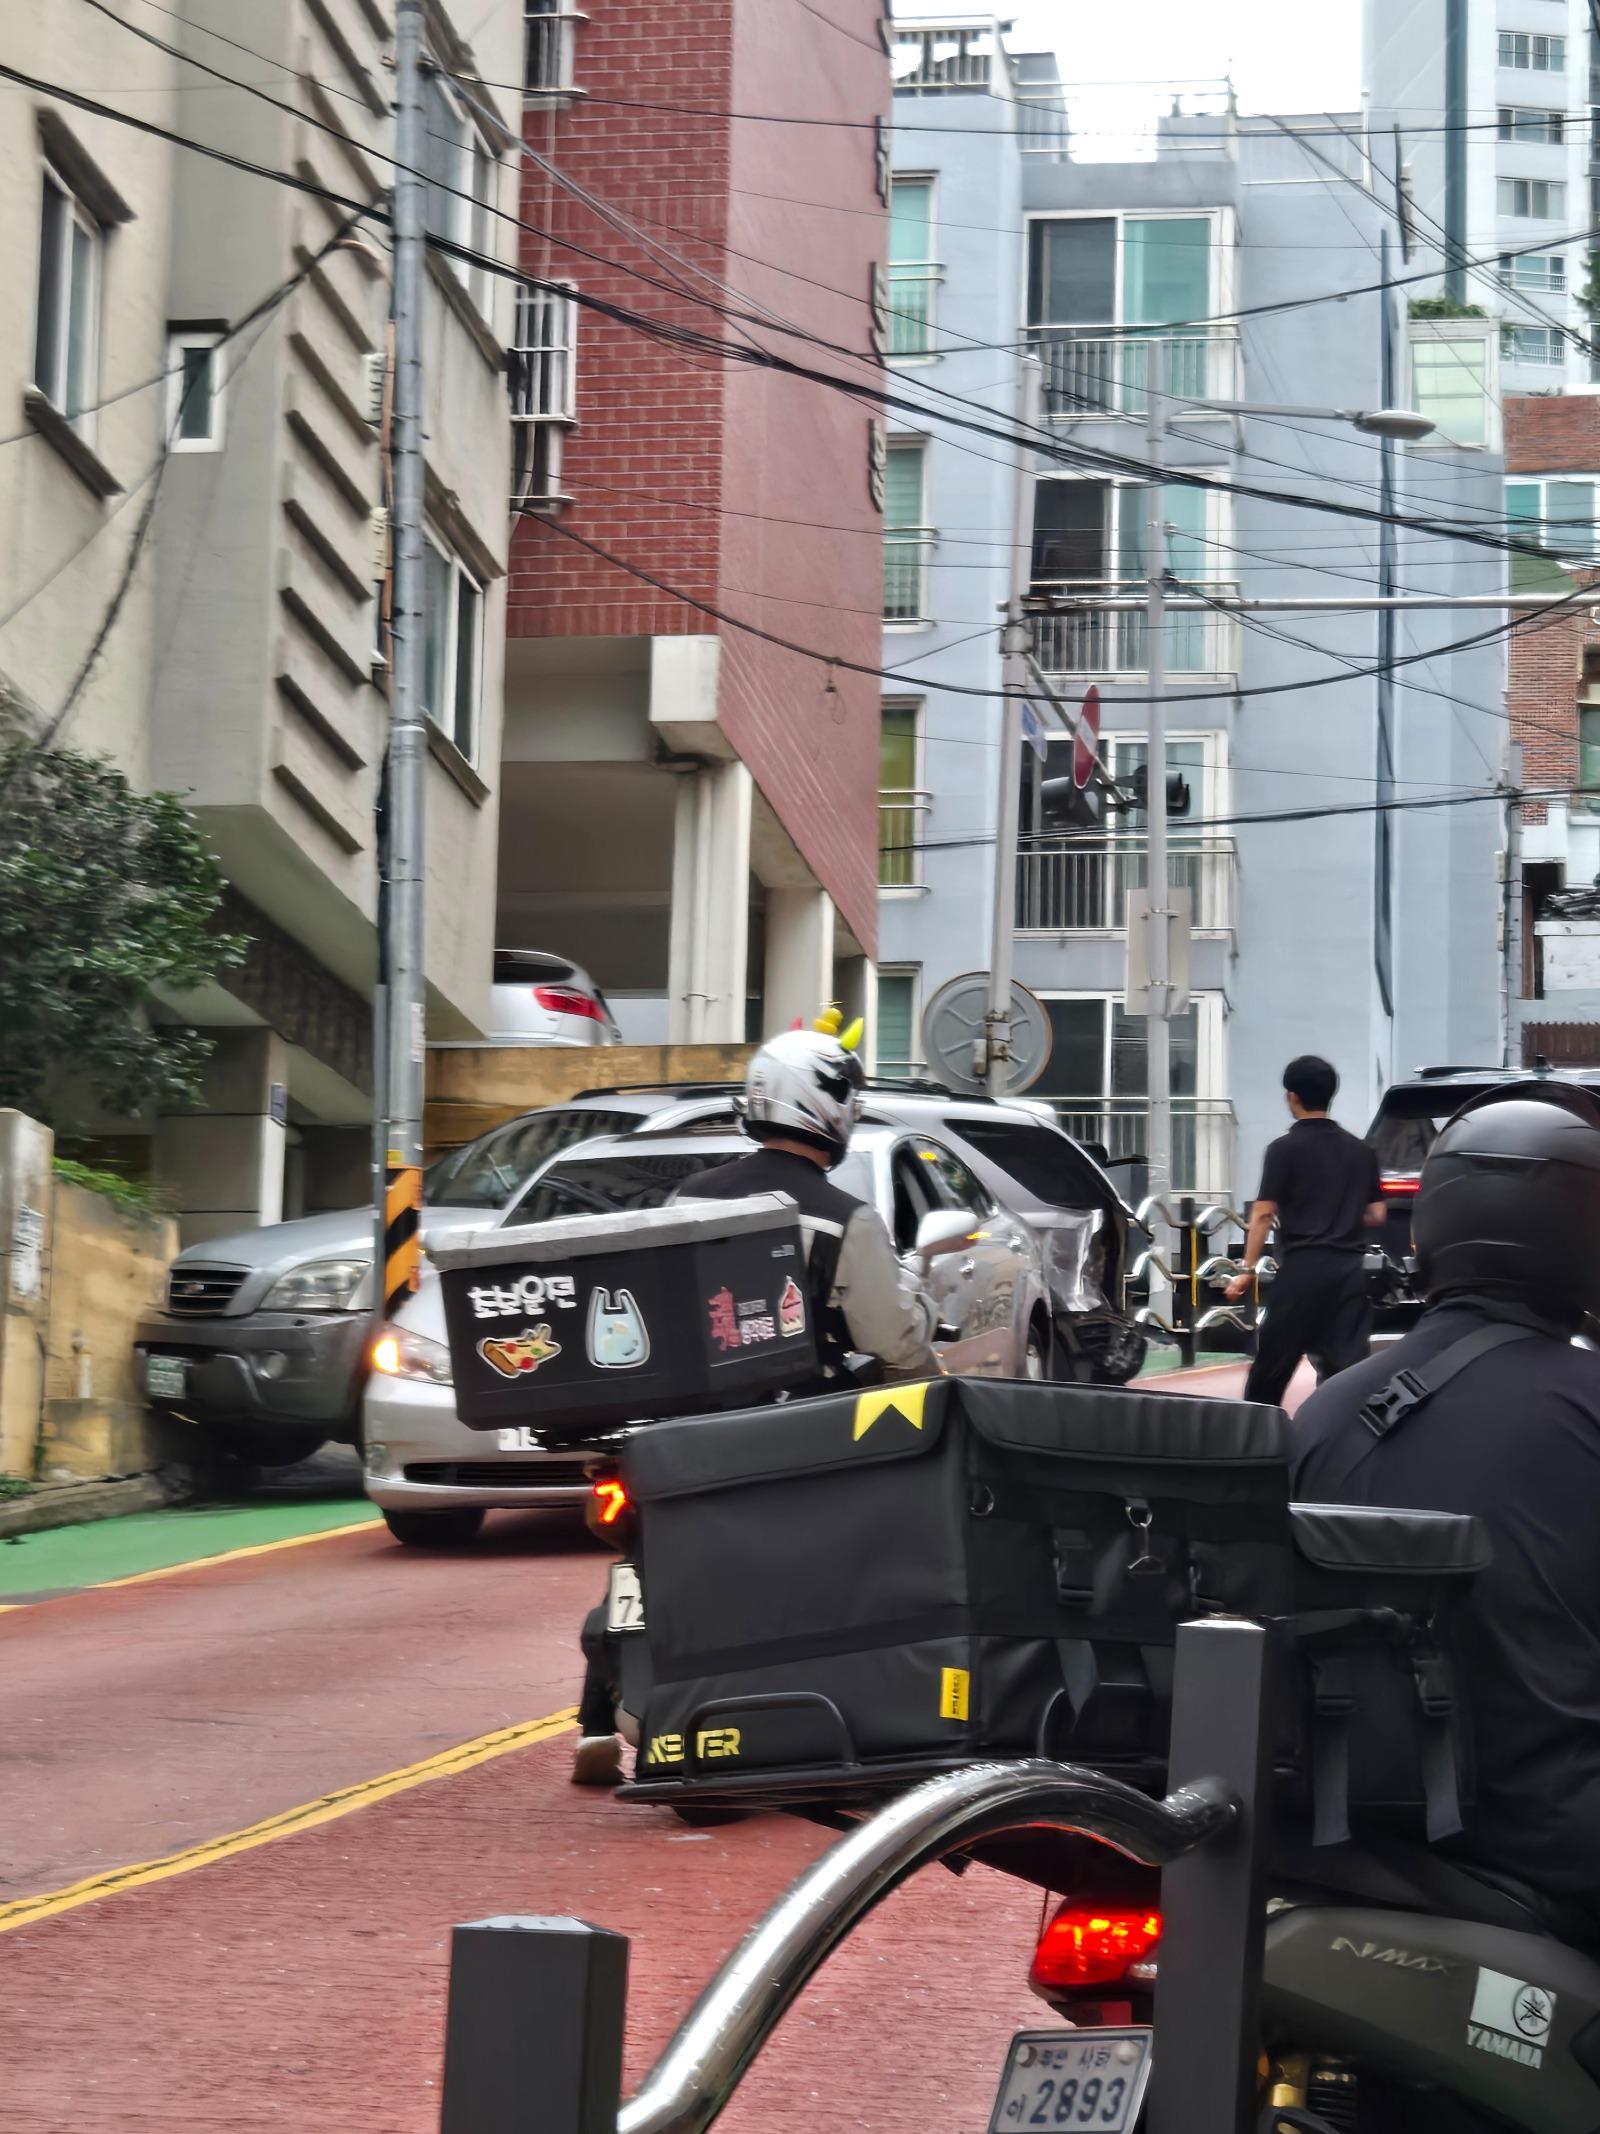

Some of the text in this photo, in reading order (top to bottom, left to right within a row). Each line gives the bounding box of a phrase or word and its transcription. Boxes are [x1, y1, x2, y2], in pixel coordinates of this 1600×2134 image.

[467, 1275, 577, 1319] 초보운전
[1467, 2024, 1543, 2070] YAMAHA
[1029, 2077, 1127, 2124] 2893
